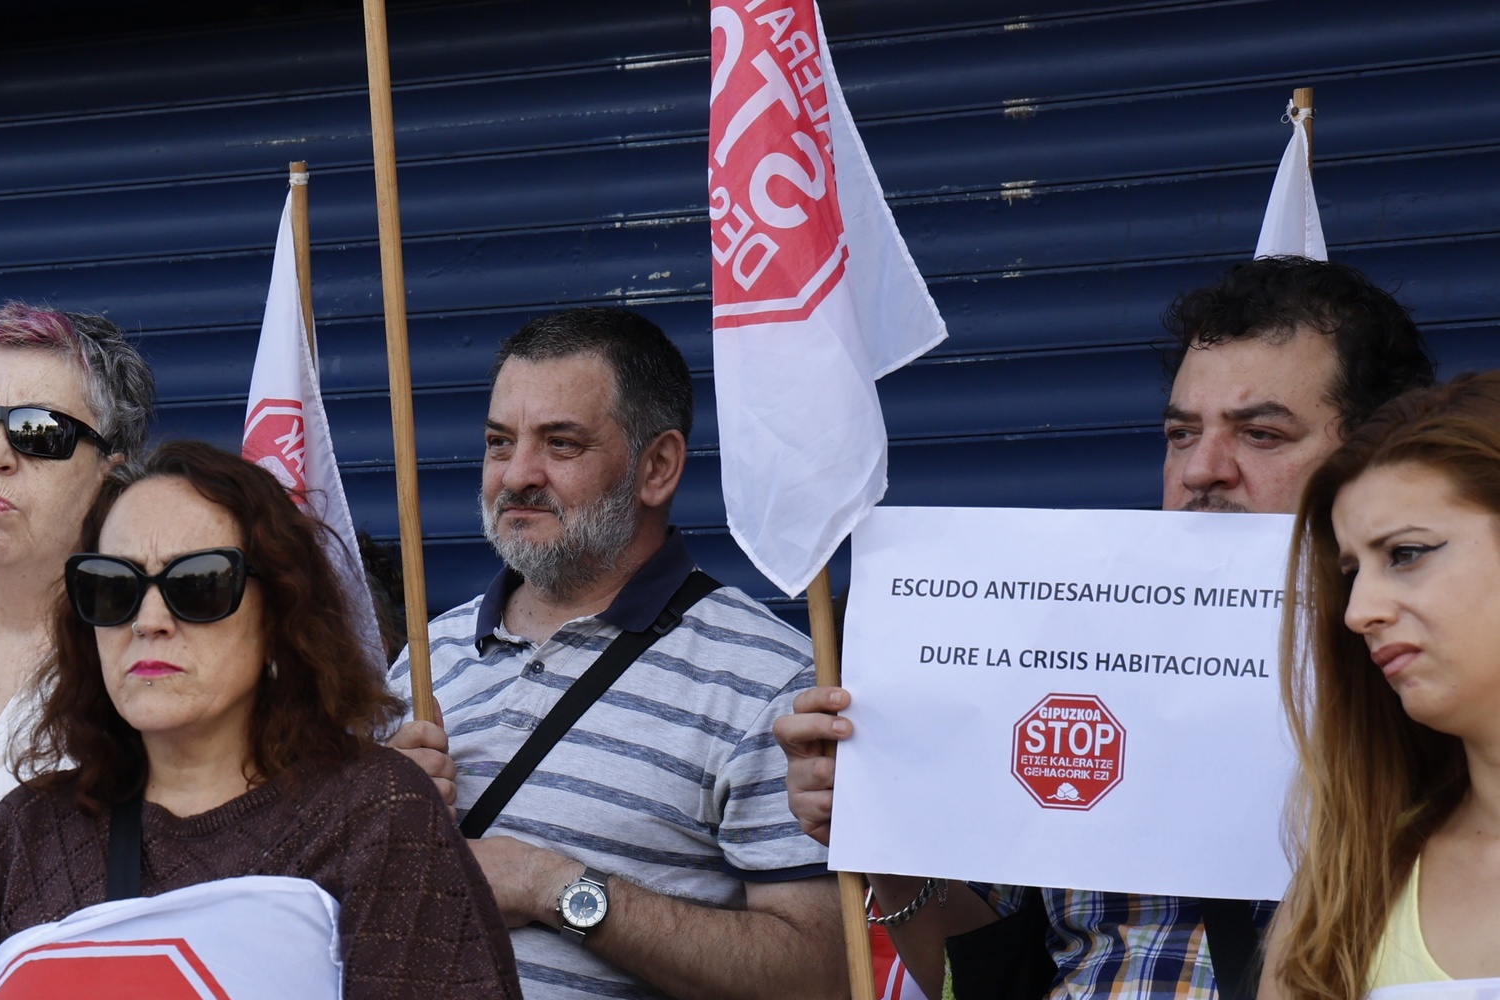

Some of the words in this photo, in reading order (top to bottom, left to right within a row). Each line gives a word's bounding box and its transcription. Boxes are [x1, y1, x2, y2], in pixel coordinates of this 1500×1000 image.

[891, 578, 978, 598] ESCUDO
[984, 581, 1186, 606] ANTIDESAHUCIOS
[1194, 587, 1287, 609] MIENTR
[919, 645, 979, 666] DURE
[986, 648, 1012, 667] LA
[1018, 650, 1088, 671] CRISIS
[1095, 653, 1270, 678] HABITACIONAL
[1038, 706, 1102, 721] GIPUZKOA
[1024, 719, 1115, 757] STOP
[1020, 755, 1048, 766] ETXE
[1049, 756, 1114, 770] KALERATZE
[1023, 766, 1091, 780] GEHIAGORIK
